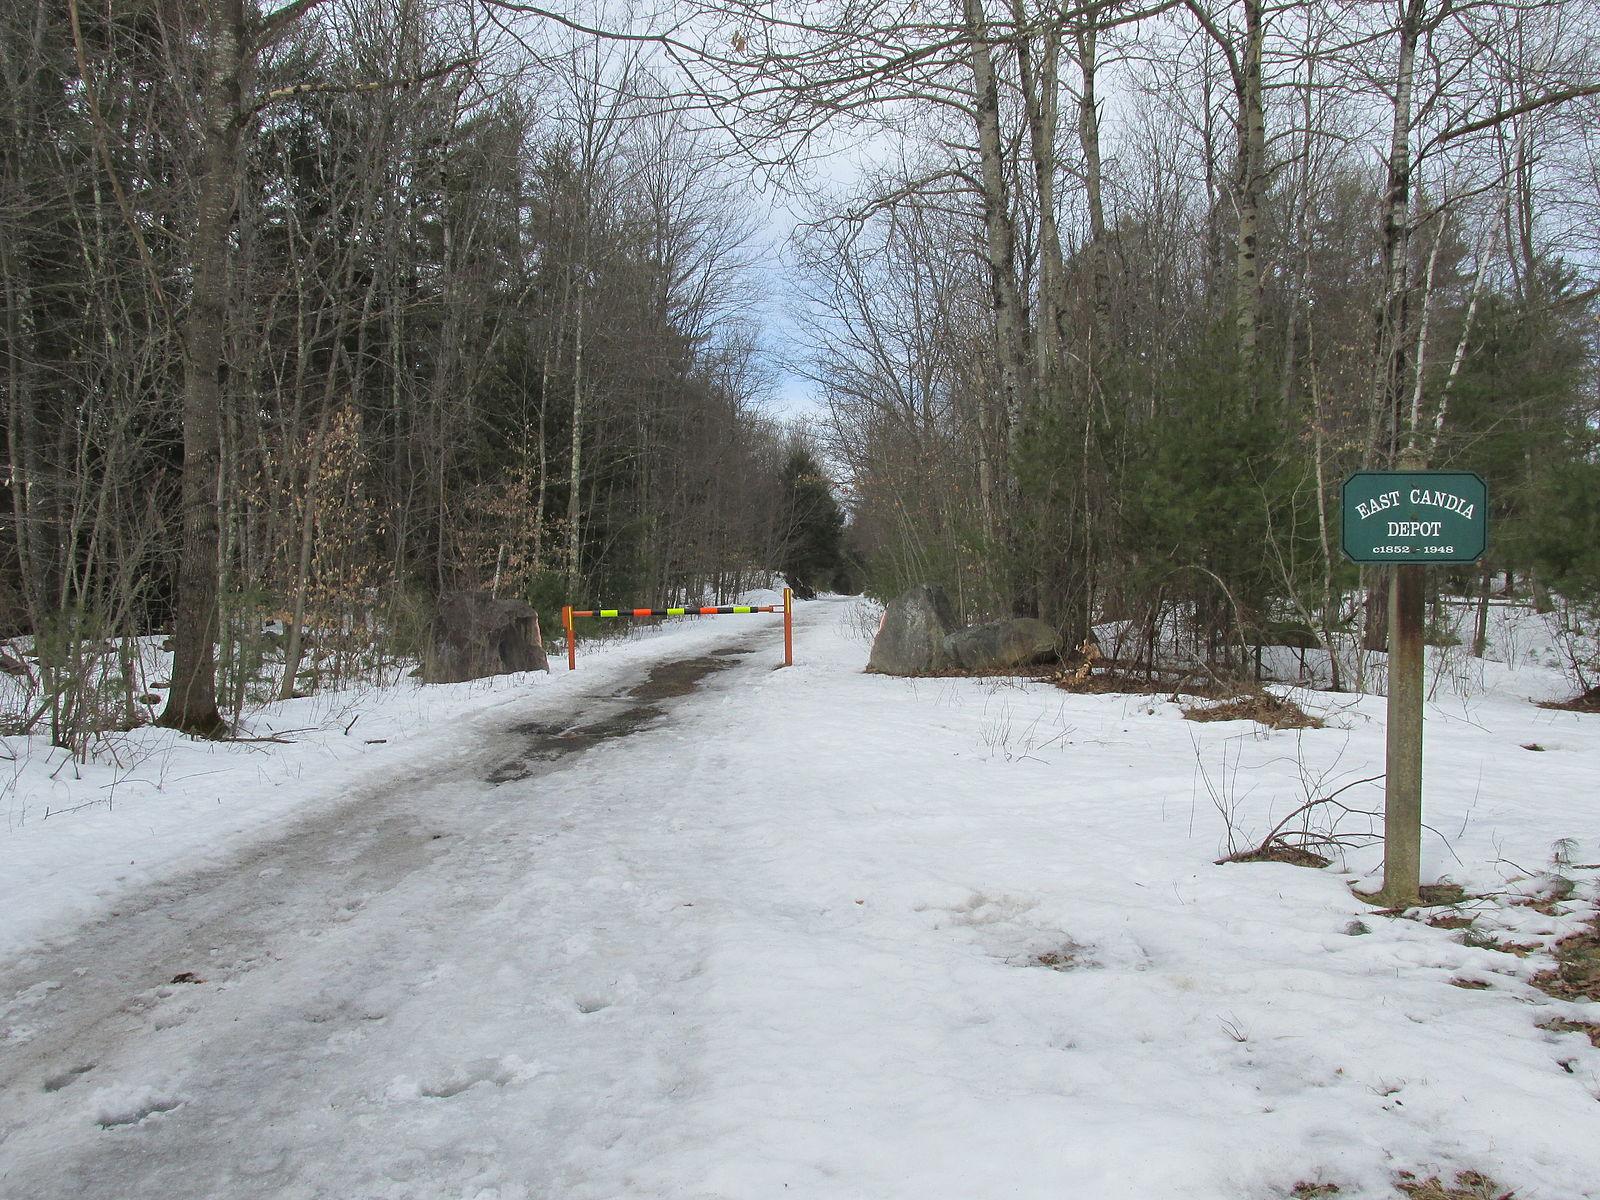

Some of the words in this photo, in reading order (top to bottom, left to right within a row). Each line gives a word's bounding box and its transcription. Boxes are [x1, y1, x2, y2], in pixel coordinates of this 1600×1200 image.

[1355, 490, 1400, 520] EAST
[1409, 489, 1475, 520] CANDIA
[1387, 521, 1442, 537] DEPOT
[1372, 545, 1411, 554] c1852
[1423, 545, 1454, 554] 1948
